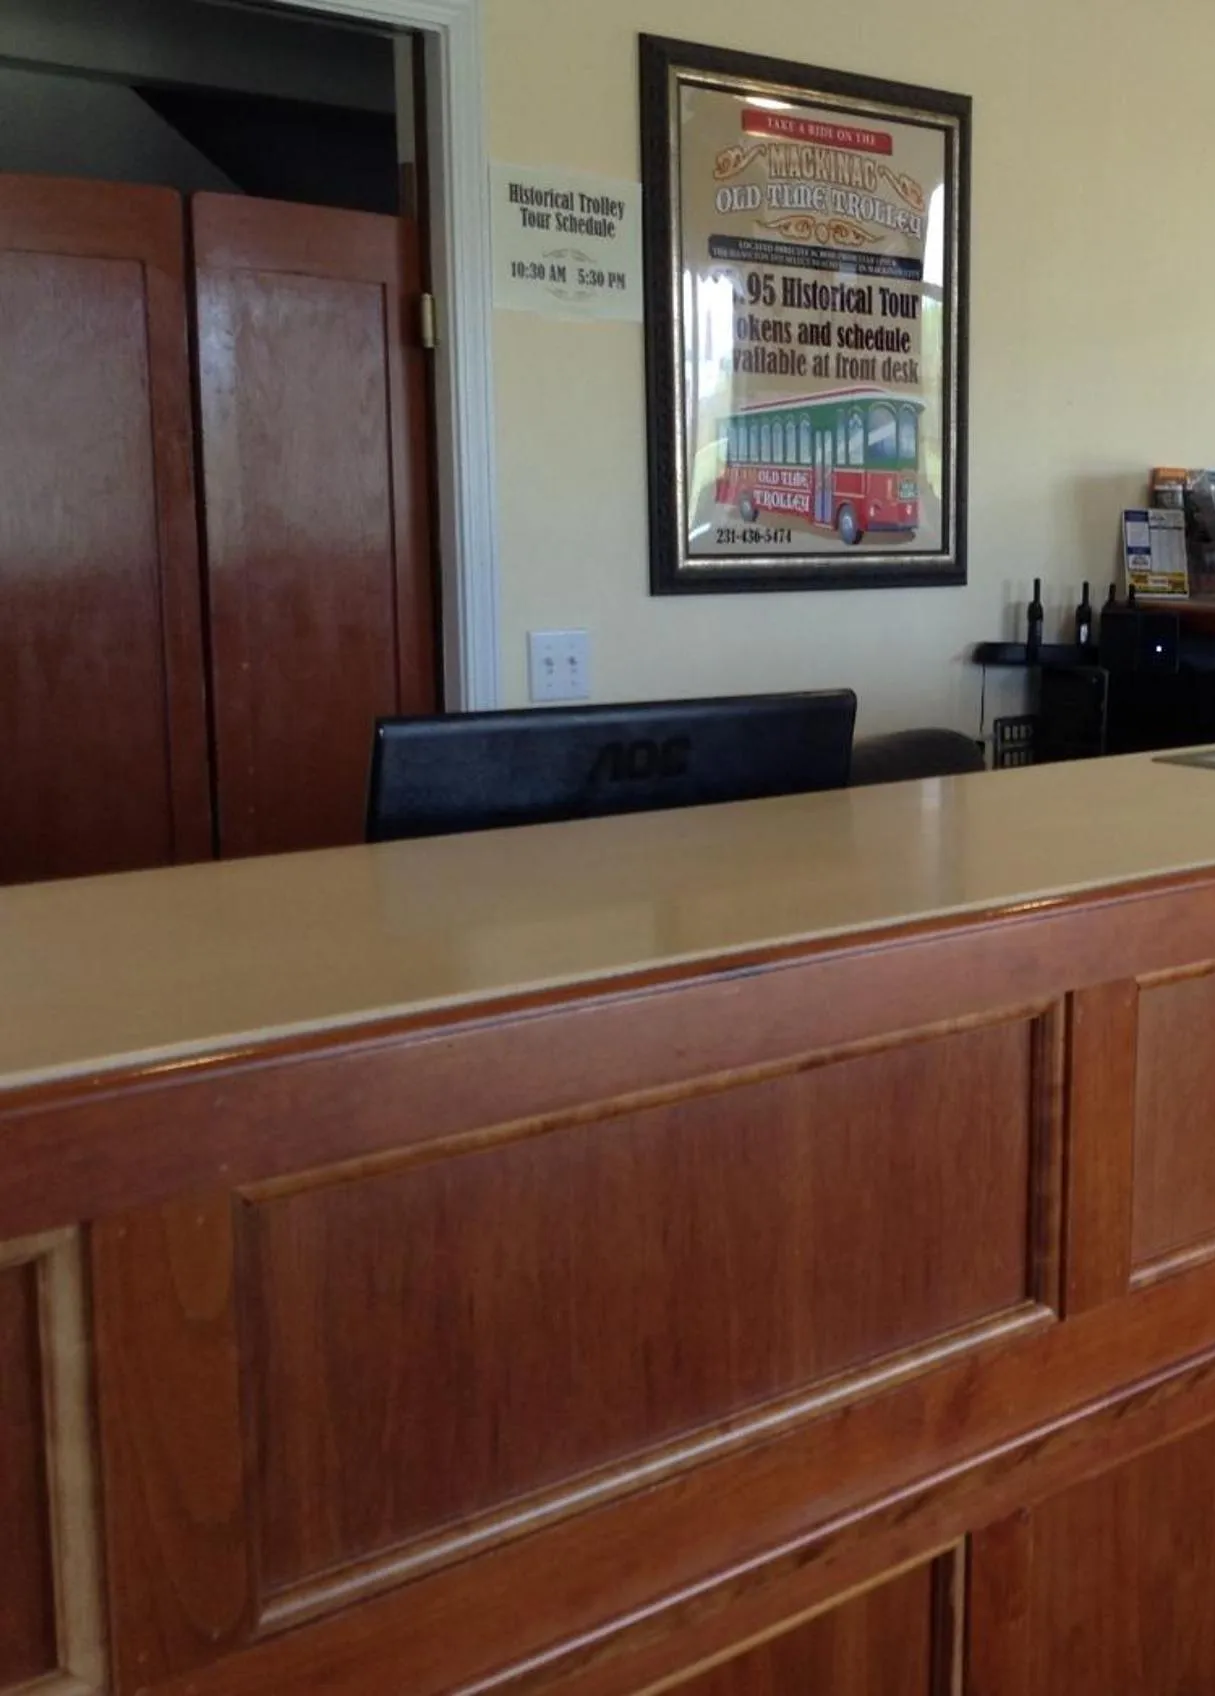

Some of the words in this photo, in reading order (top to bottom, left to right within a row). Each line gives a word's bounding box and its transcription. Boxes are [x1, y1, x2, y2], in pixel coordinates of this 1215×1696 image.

[766, 117, 794, 133] TAKE
[799, 124, 806, 134] A
[837, 130, 853, 143] ON
[766, 142, 879, 194] MACKINAC
[508, 182, 575, 212] Historical
[578, 192, 625, 221] Trolley
[715, 184, 762, 214] OLD
[520, 207, 551, 231] Tour
[555, 212, 616, 239] Schedule
[510, 261, 546, 281] 10:30
[548, 264, 567, 283] AM
[577, 268, 605, 288] 5:30
[607, 271, 626, 290] PM
[781, 275, 873, 315] Historical
[878, 286, 920, 320] Tour
[735, 314, 792, 345] okens
[797, 321, 832, 348] and
[837, 323, 912, 354] schedule
[731, 348, 808, 377] vailable
[812, 353, 831, 379] at
[835, 352, 878, 382] front
[881, 356, 919, 384] desk
[758, 470, 780, 484] OLD
[586, 736, 692, 783] AOC
